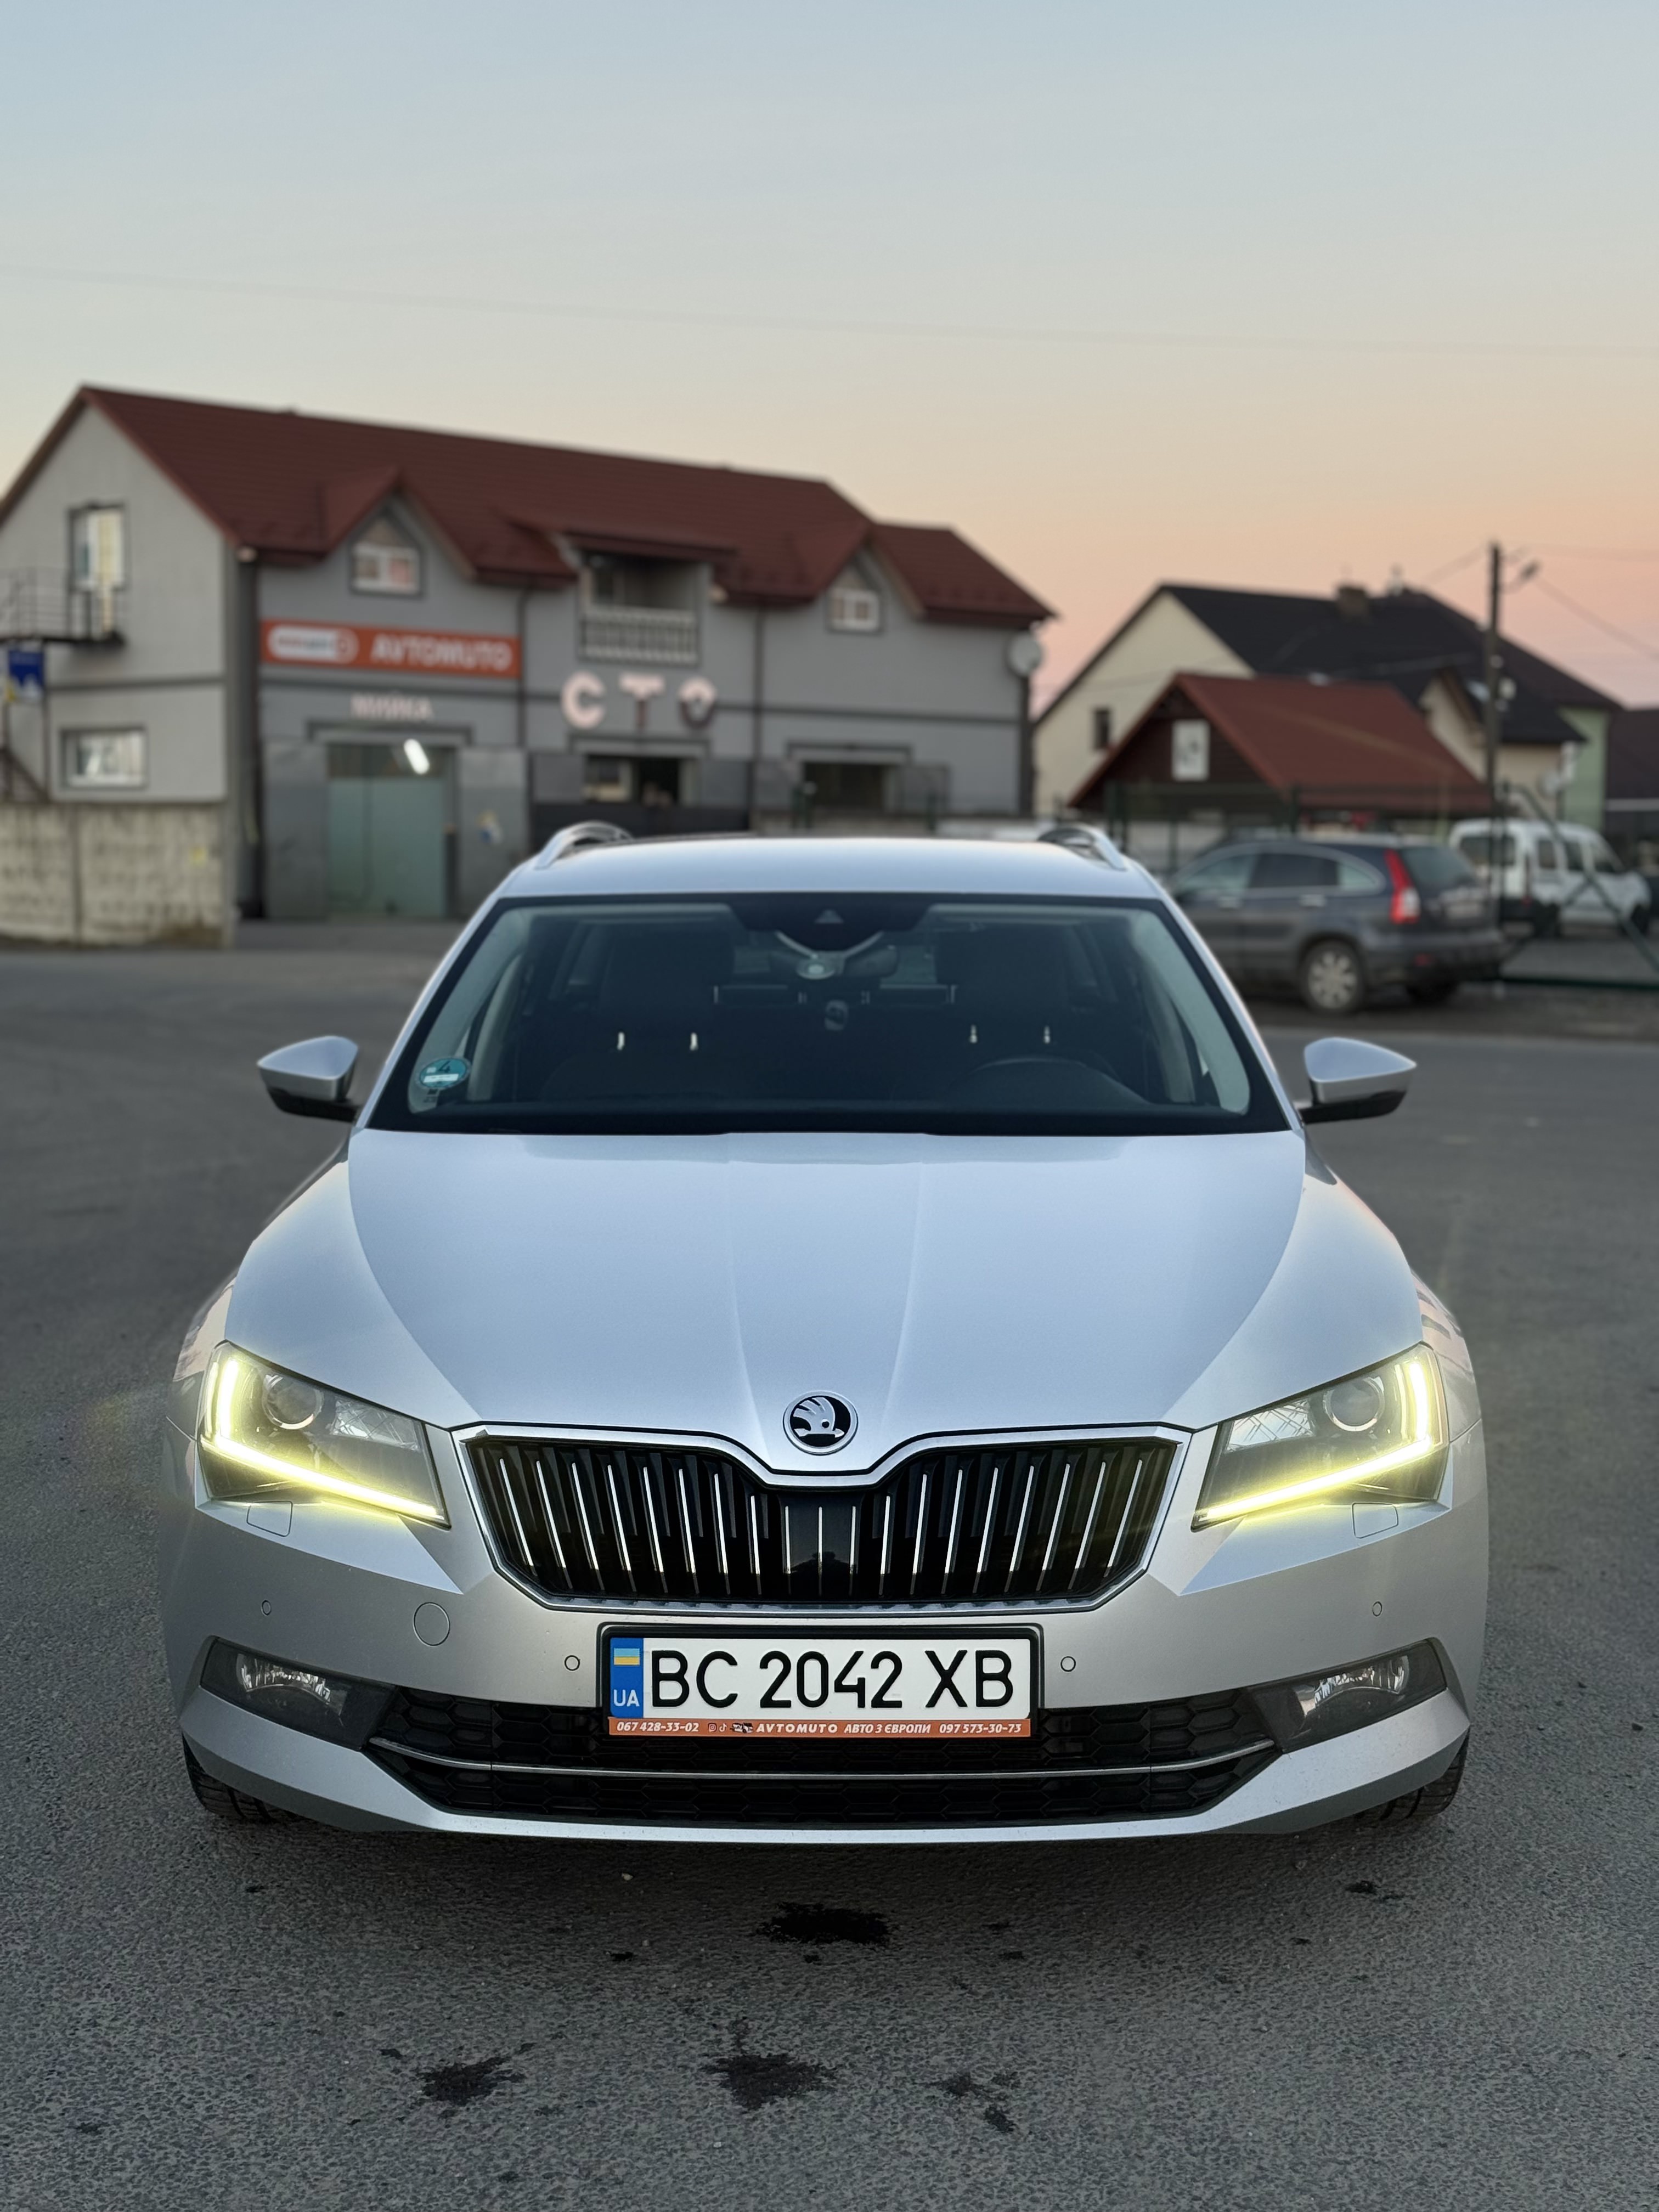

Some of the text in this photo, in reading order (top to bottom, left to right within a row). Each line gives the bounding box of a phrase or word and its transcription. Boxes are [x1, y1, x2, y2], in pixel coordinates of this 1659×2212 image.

[652, 1650, 1013, 1708] BC 2042 XB
[613, 1690, 640, 1707] UA
[617, 1722, 699, 1733] 067 428-33-02
[756, 1723, 838, 1734] AVTOMUTO
[844, 1724, 874, 1734] АВТО
[884, 1724, 932, 1734] ЄВРОПИ
[939, 1724, 1022, 1734] 097 573-30-73
